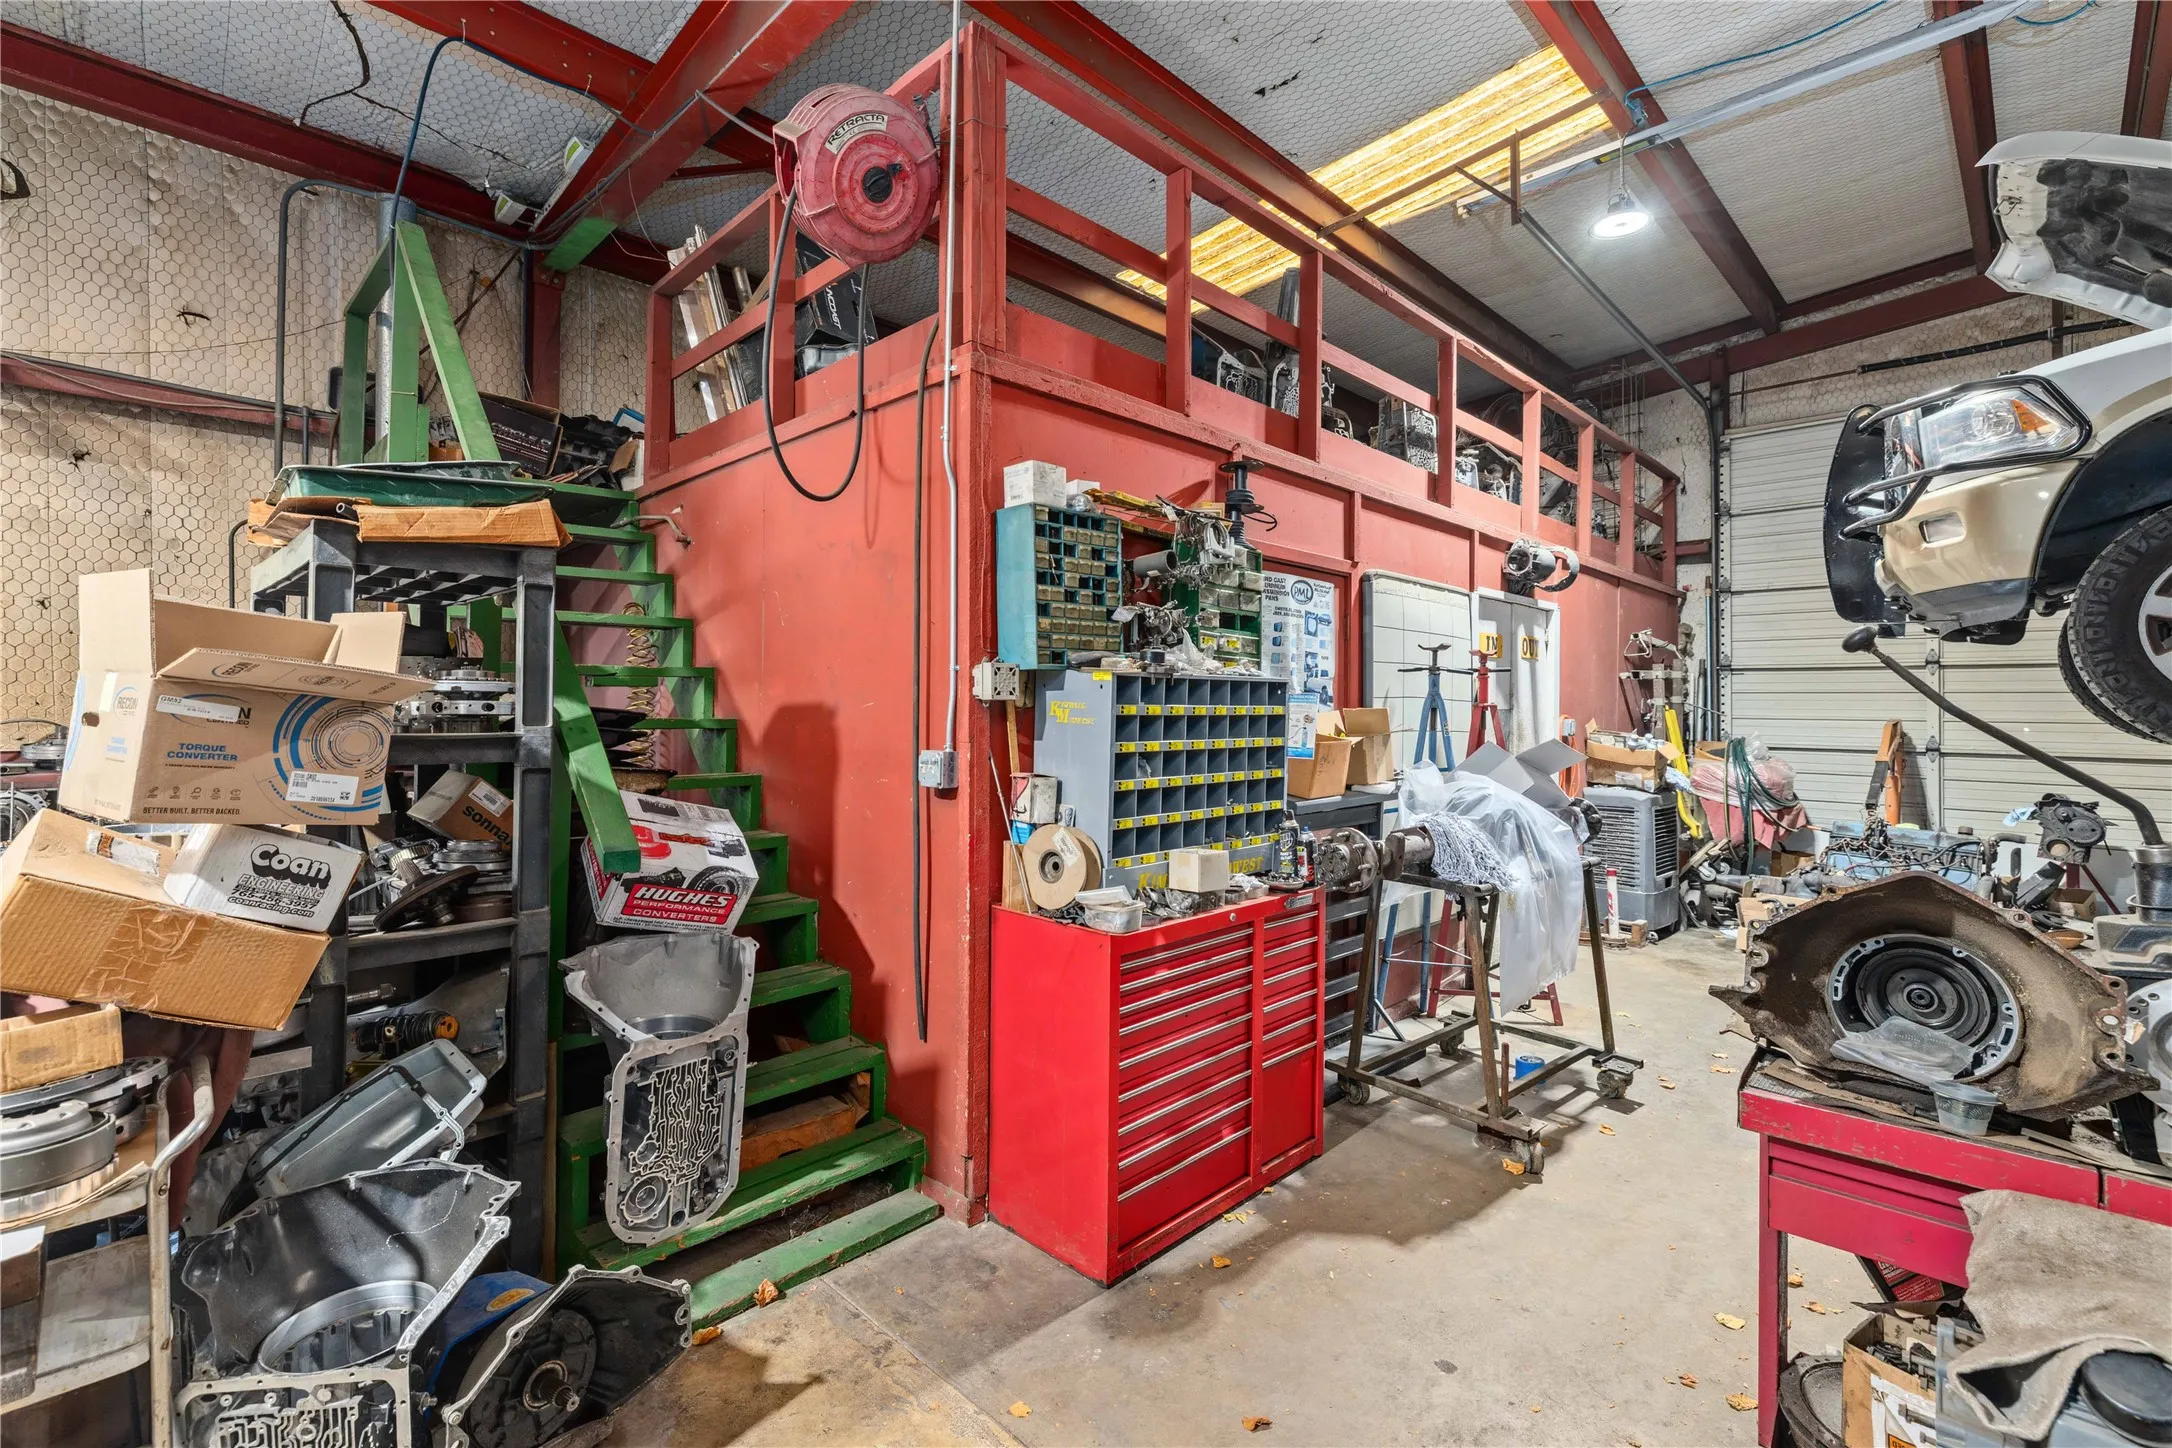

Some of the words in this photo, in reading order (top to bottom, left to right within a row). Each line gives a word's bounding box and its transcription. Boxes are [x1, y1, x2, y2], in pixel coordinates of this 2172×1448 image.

[828, 115, 884, 145] RETRACTA
[1294, 585, 1312, 600] PML
[1486, 636, 1499, 651] IN
[1522, 637, 1539, 657] OUT
[178, 742, 227, 752] TORQUE
[167, 751, 238, 762] CONVERTER
[143, 806, 169, 815] BETTER
[190, 807, 215, 815] BETTER
[251, 843, 331, 889] Coan
[238, 873, 326, 899] ENGINEERING
[231, 887, 317, 909] 765-456-3957
[634, 886, 733, 907] HUGHES
[227, 896, 315, 918] coanracing.com
[633, 899, 727, 915] PERFORMANCE
[633, 908, 718, 923] CONVERTERS
